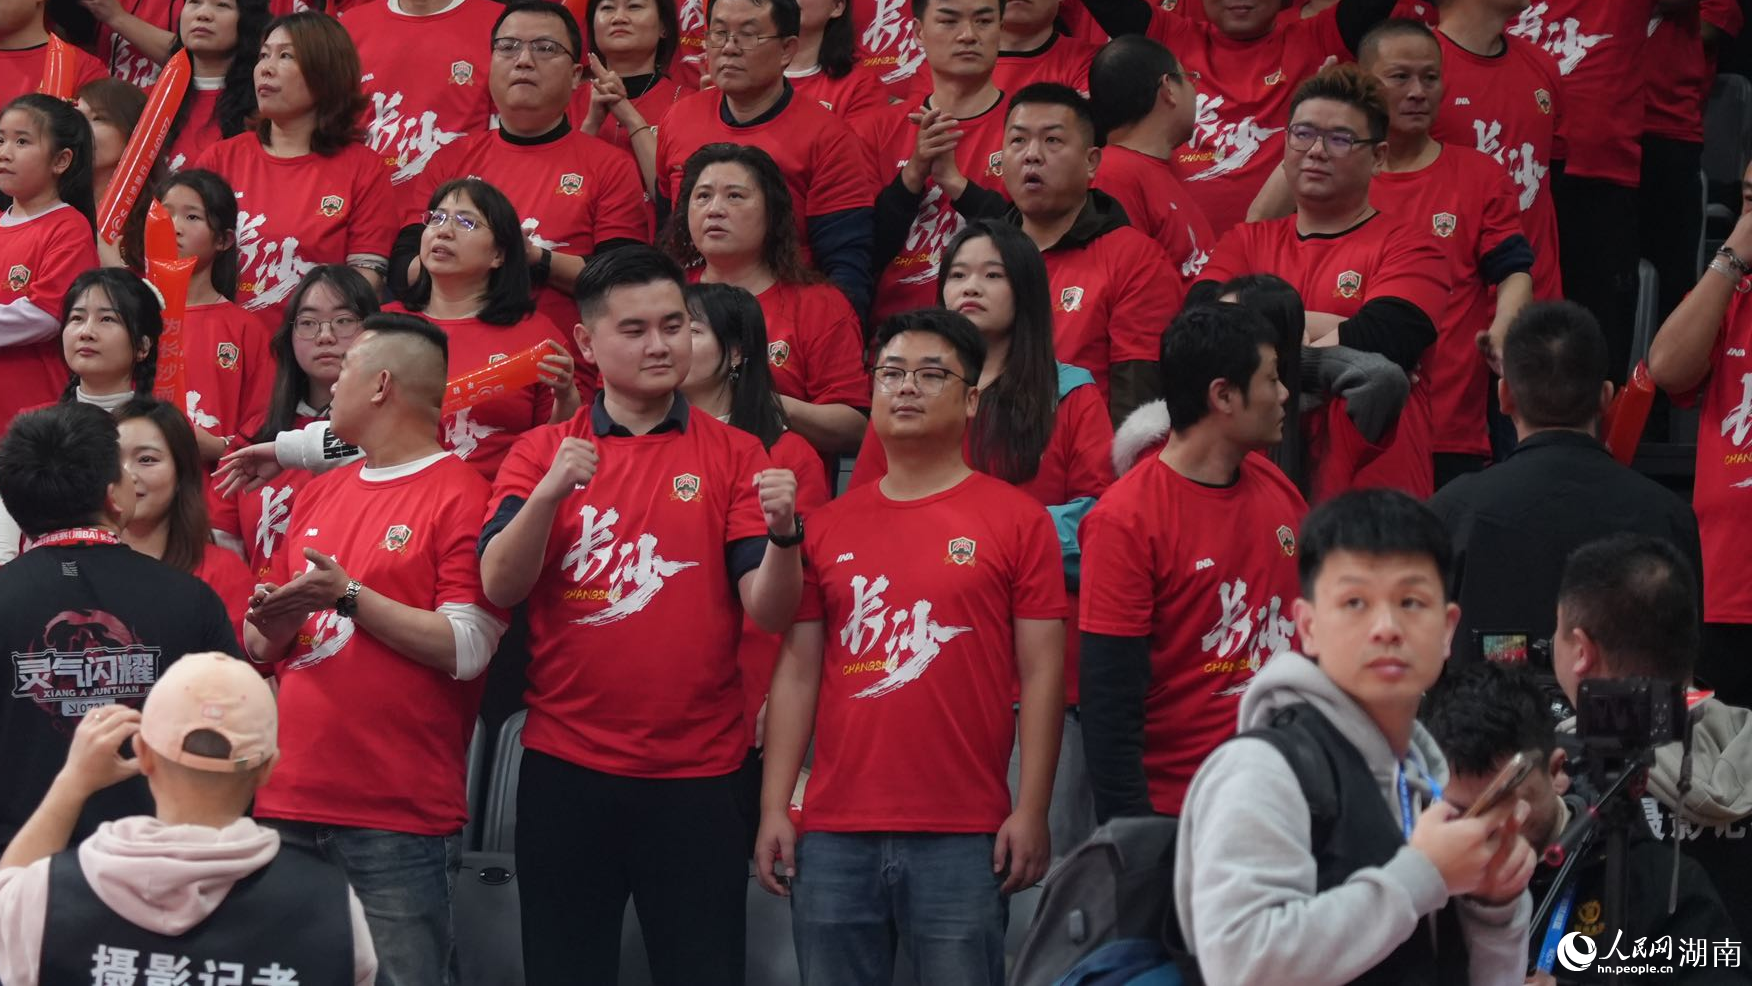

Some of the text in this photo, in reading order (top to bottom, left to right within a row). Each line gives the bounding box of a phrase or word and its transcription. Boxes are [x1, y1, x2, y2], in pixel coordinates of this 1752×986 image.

[365, 91, 467, 186] 长沙
[562, 504, 700, 627] 长沙
[16, 653, 157, 691] 灵气闪耀
[840, 574, 972, 699] 长沙
[43, 689, 76, 699] XIANG
[91, 685, 140, 697] JUNTUAN
